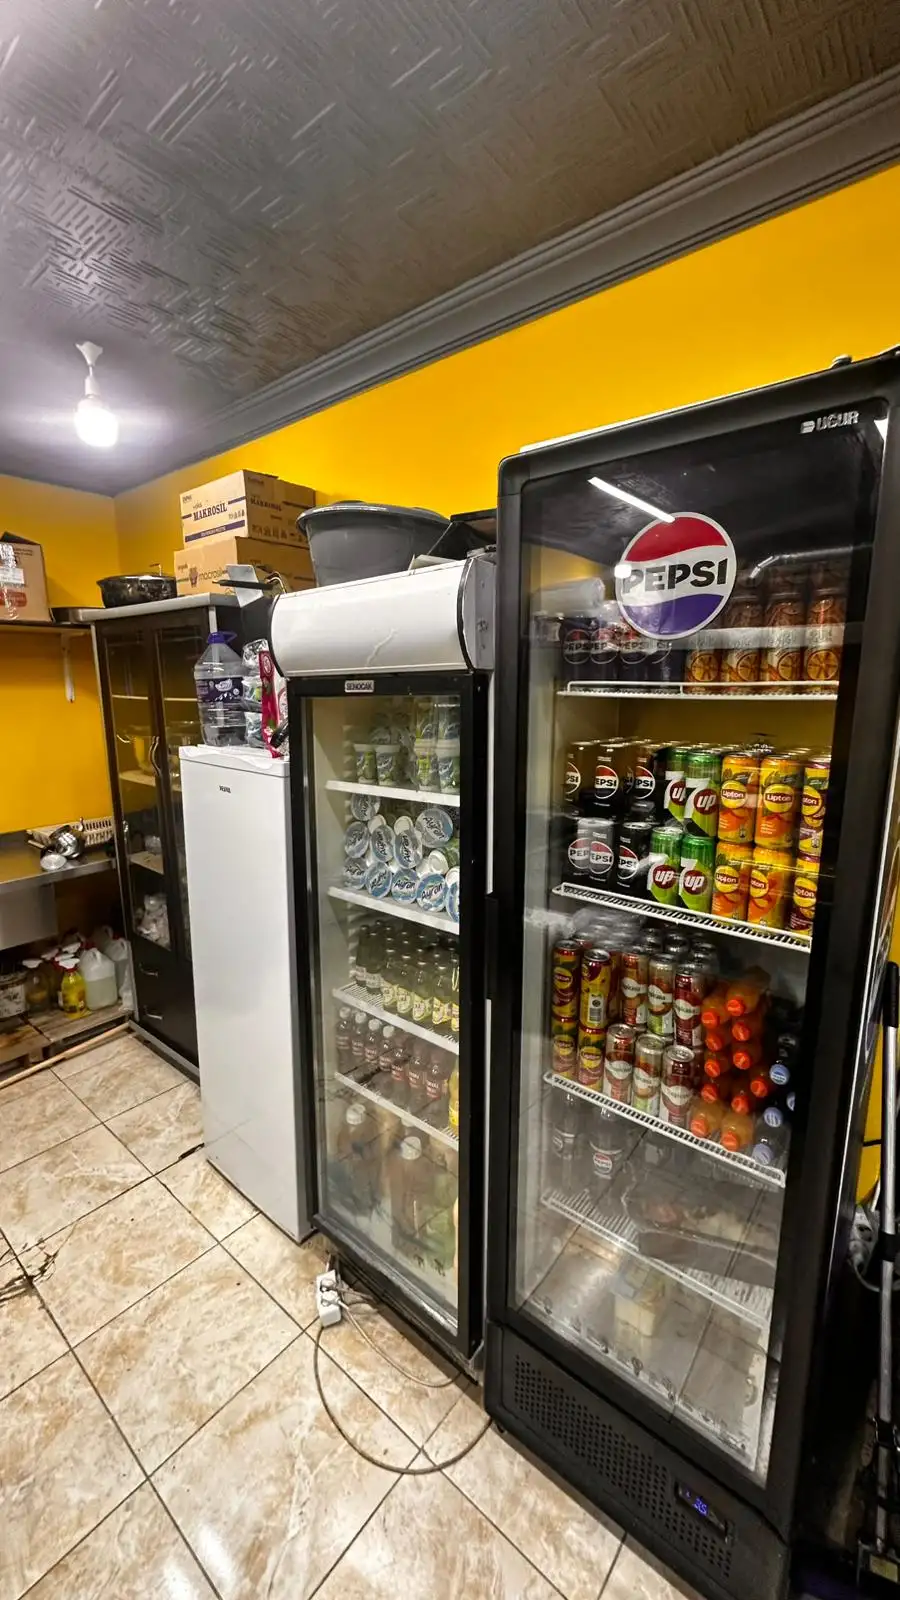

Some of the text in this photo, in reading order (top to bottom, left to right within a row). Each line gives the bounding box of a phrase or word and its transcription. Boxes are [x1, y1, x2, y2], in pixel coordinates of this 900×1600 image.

[621, 558, 728, 594] PEPSI
[595, 778, 617, 788] EPSI
[722, 789, 744, 799] Lipton
[767, 793, 791, 803] Lipton
[591, 854, 612, 864] EPSI
